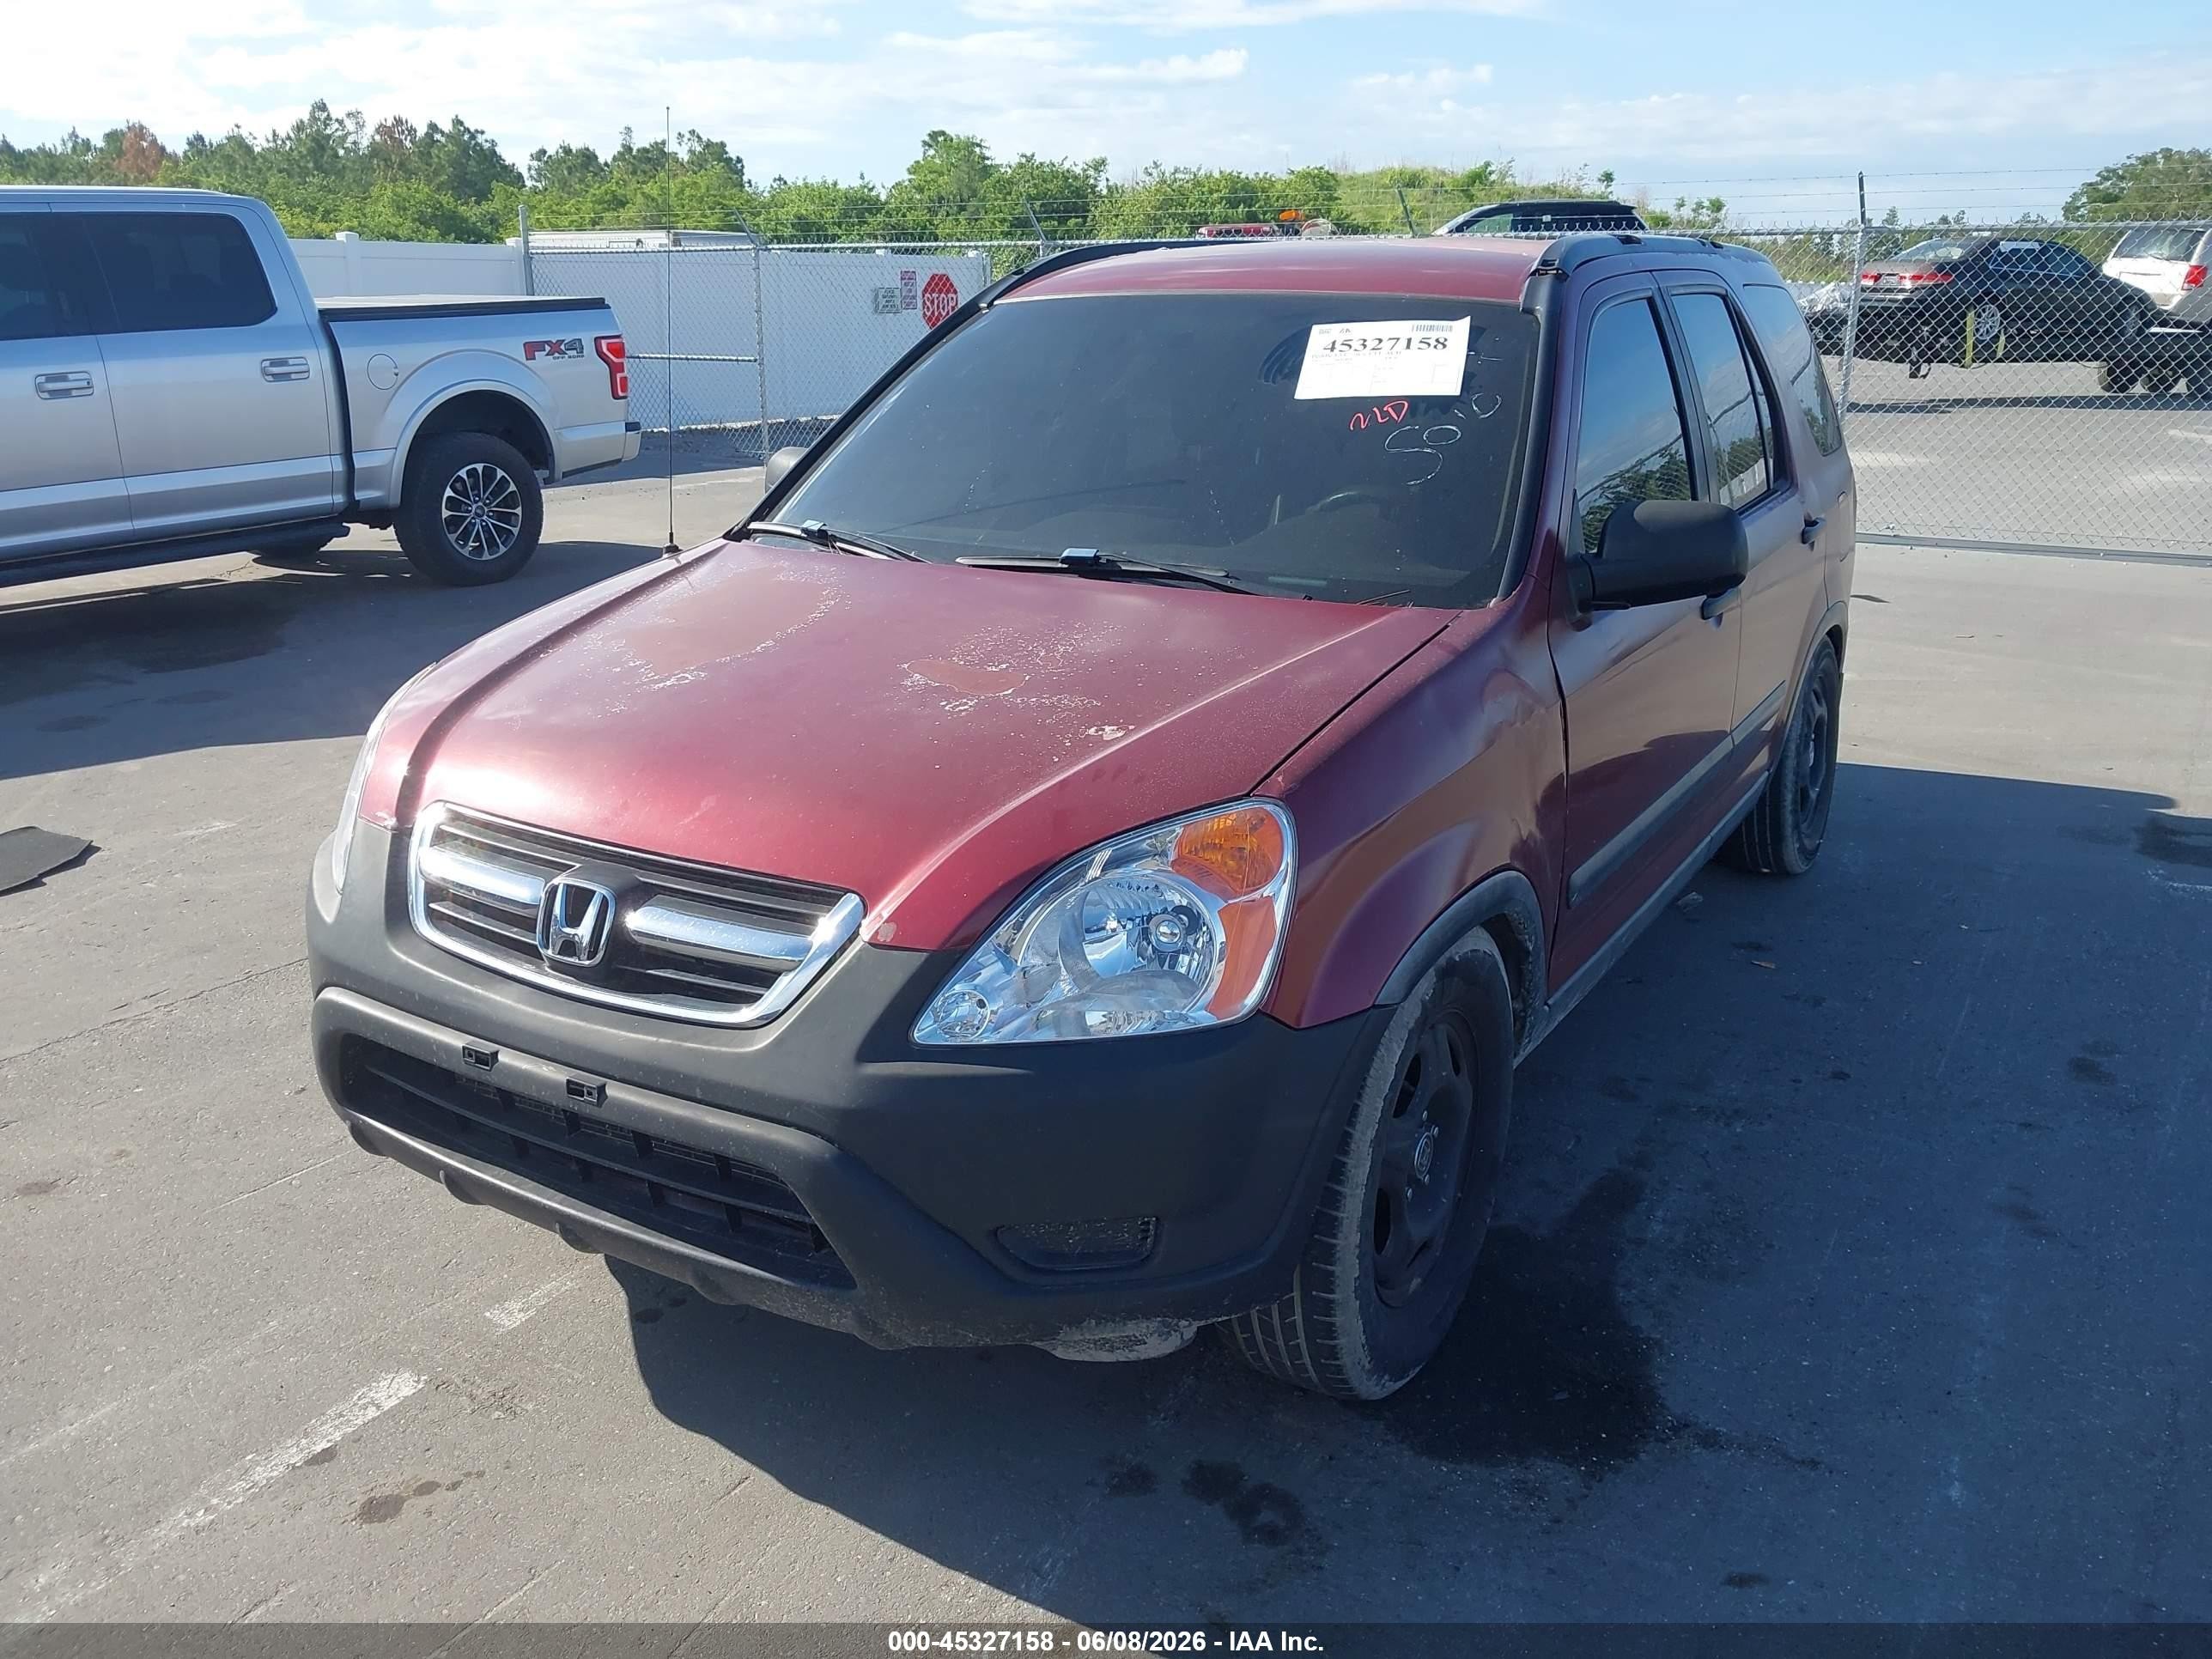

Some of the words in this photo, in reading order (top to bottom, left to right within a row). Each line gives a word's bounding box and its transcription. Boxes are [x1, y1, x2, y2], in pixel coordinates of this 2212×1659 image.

[924, 293, 957, 315] STOP
[523, 337, 584, 361] FX4
[1322, 337, 1449, 352] 45327158
